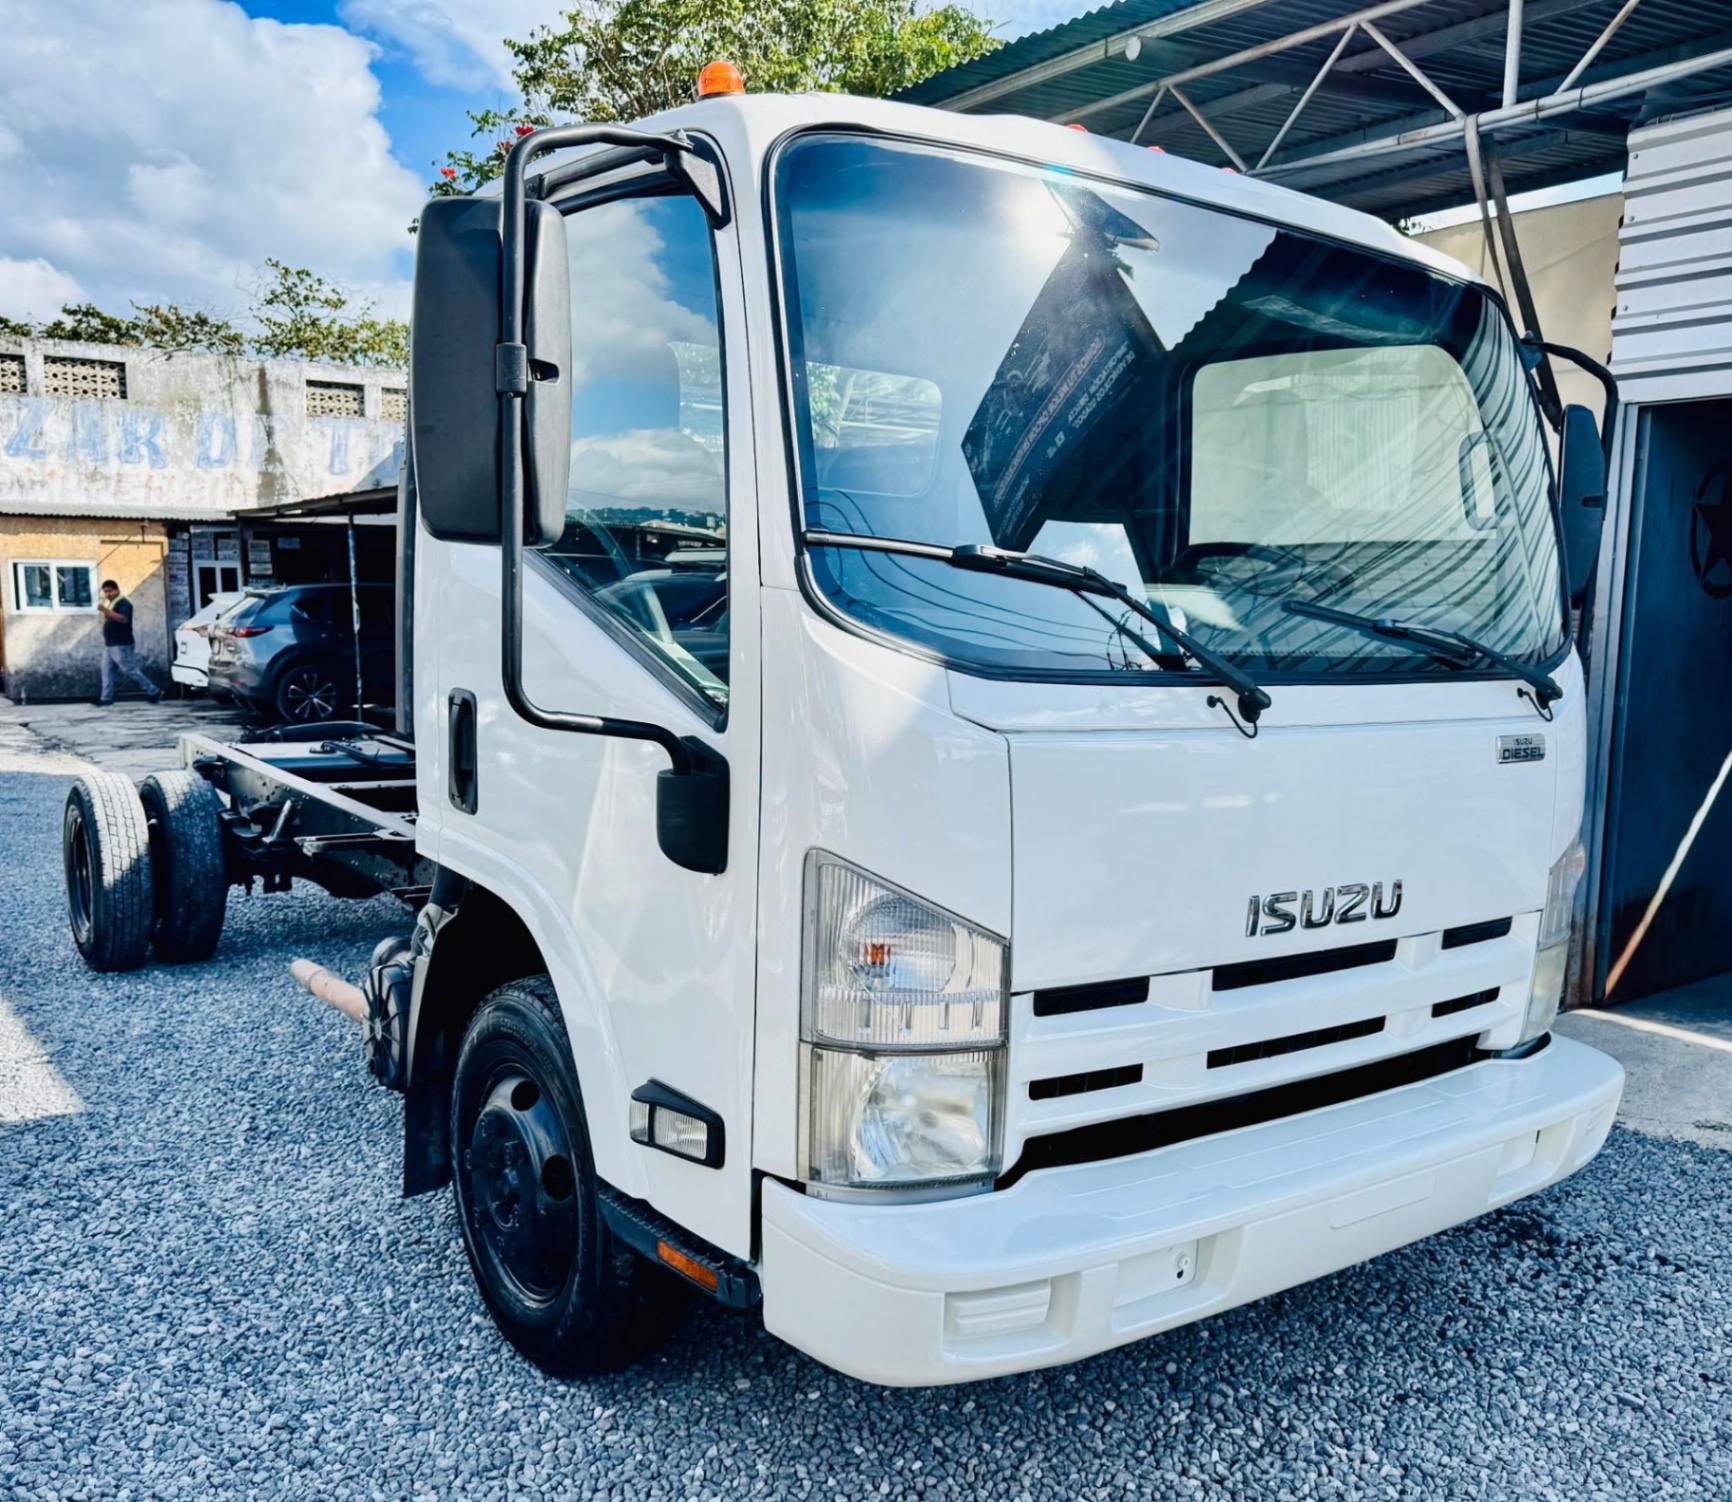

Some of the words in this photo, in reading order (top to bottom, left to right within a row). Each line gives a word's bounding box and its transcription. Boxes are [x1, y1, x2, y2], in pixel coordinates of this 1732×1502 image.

[1513, 737, 1533, 746] ISUZU
[1502, 746, 1545, 760] DIESEL
[1246, 879, 1403, 937] ISUZU
